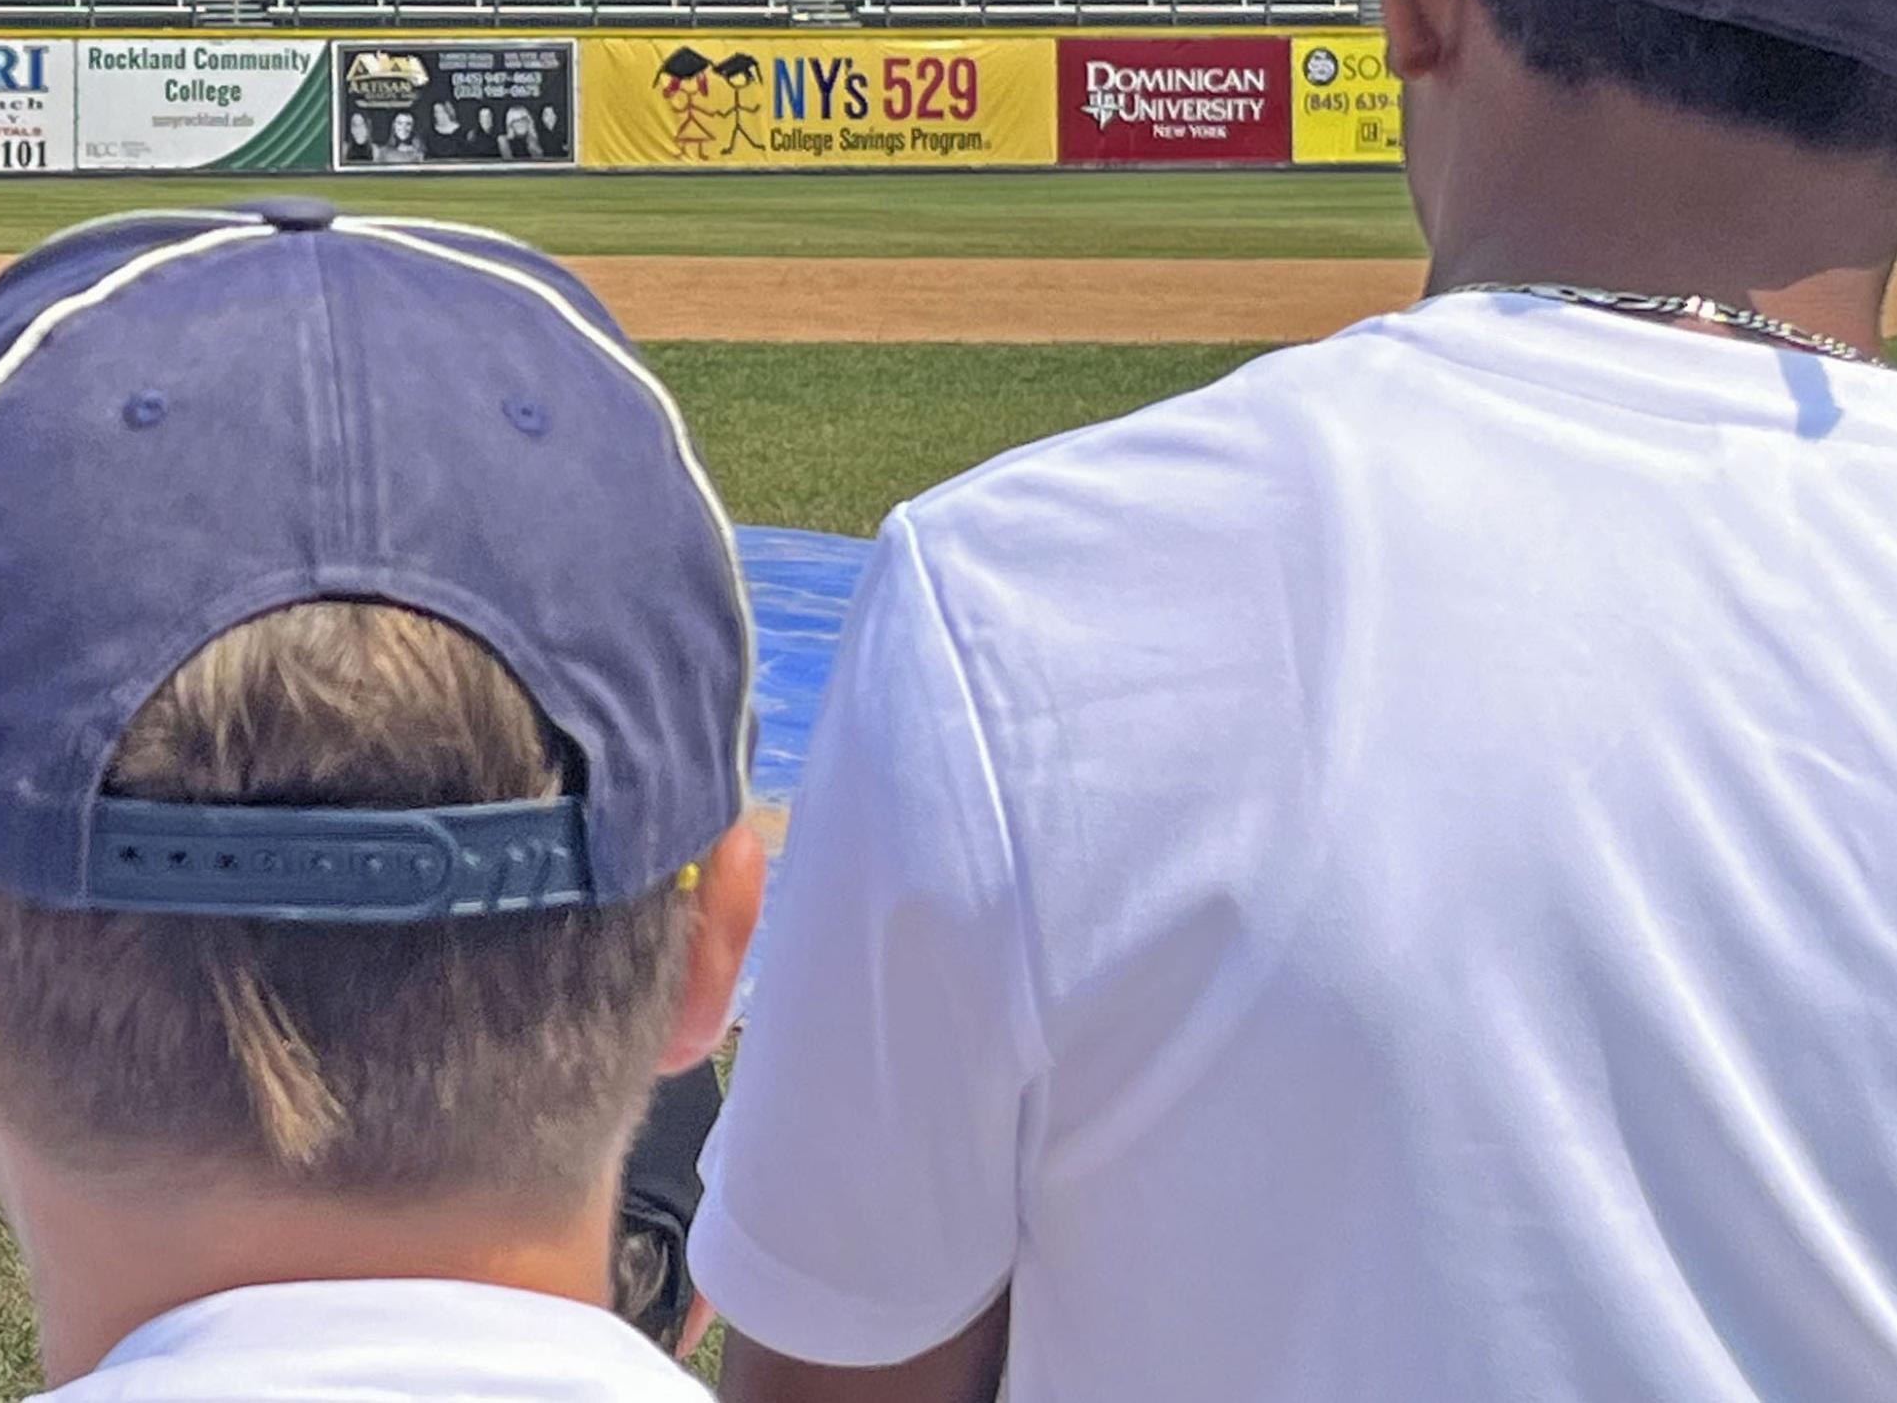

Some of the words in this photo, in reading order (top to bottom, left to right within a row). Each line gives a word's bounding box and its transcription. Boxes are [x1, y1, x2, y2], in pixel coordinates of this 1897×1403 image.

[88, 47, 186, 71] Rockland
[193, 47, 312, 75] Community
[1343, 54, 1389, 81] SO
[773, 56, 868, 120] NY's
[882, 56, 978, 121] 529
[1086, 60, 1265, 93] DOMINICAN
[164, 79, 242, 107] College
[1303, 92, 1350, 116] (845)
[1355, 92, 1401, 111] 639-
[1118, 93, 1265, 122] UNIVERSITY
[770, 127, 833, 156] College
[839, 127, 906, 155] Savings
[911, 128, 983, 156] Program
